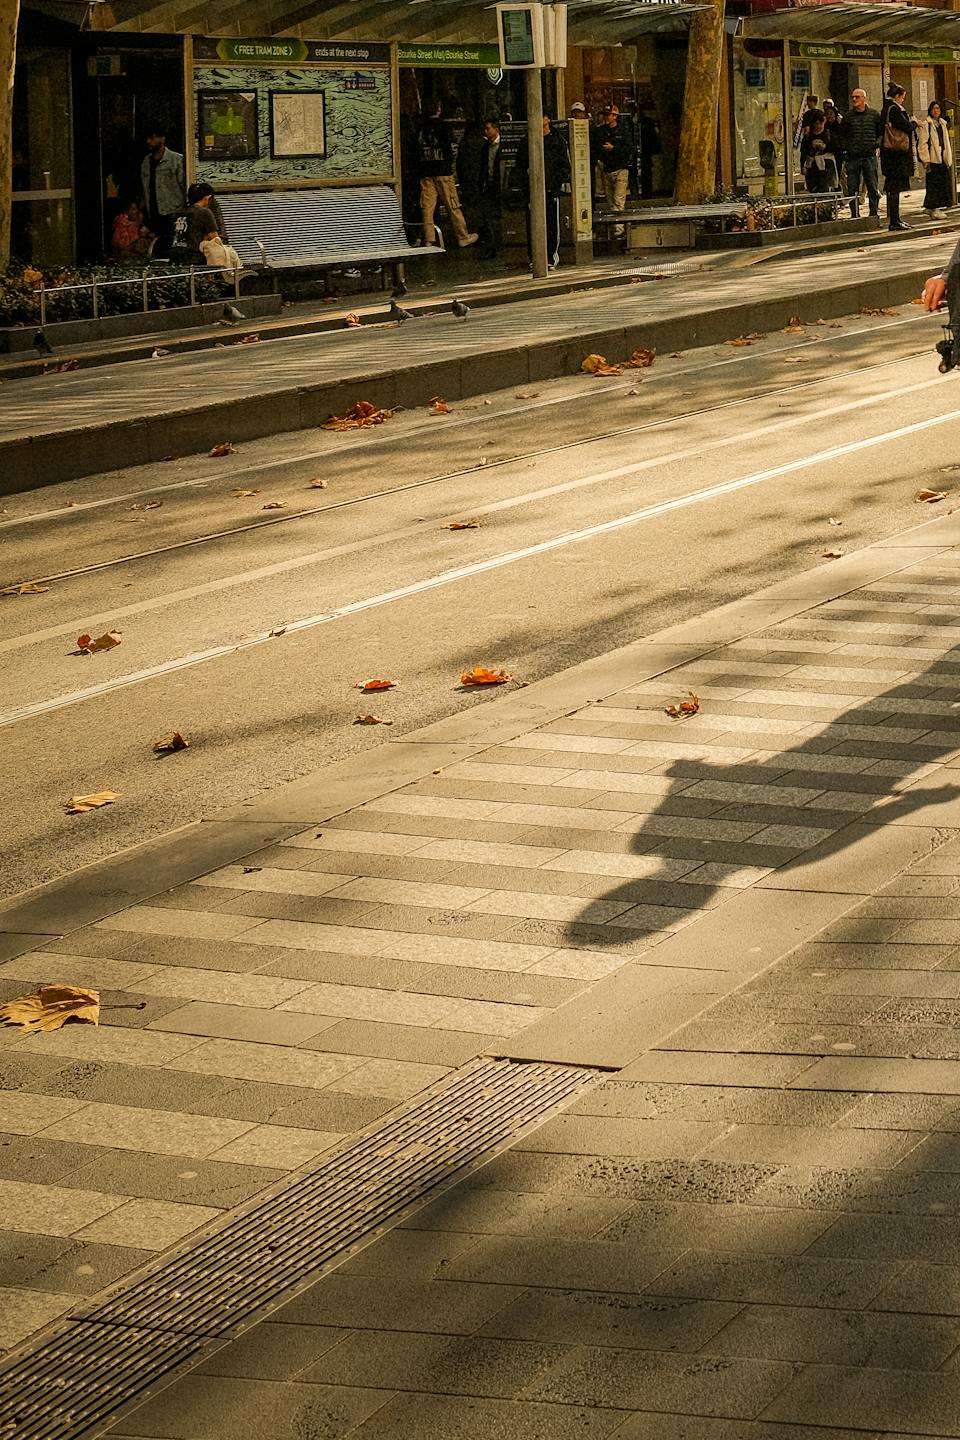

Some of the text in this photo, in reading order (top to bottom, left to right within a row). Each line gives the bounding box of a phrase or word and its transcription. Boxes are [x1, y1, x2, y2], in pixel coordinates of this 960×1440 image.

[238, 45, 370, 60] FREE TRAM ZONE ends at the next stop
[417, 50, 433, 59] Street
[463, 50, 480, 60] Street
